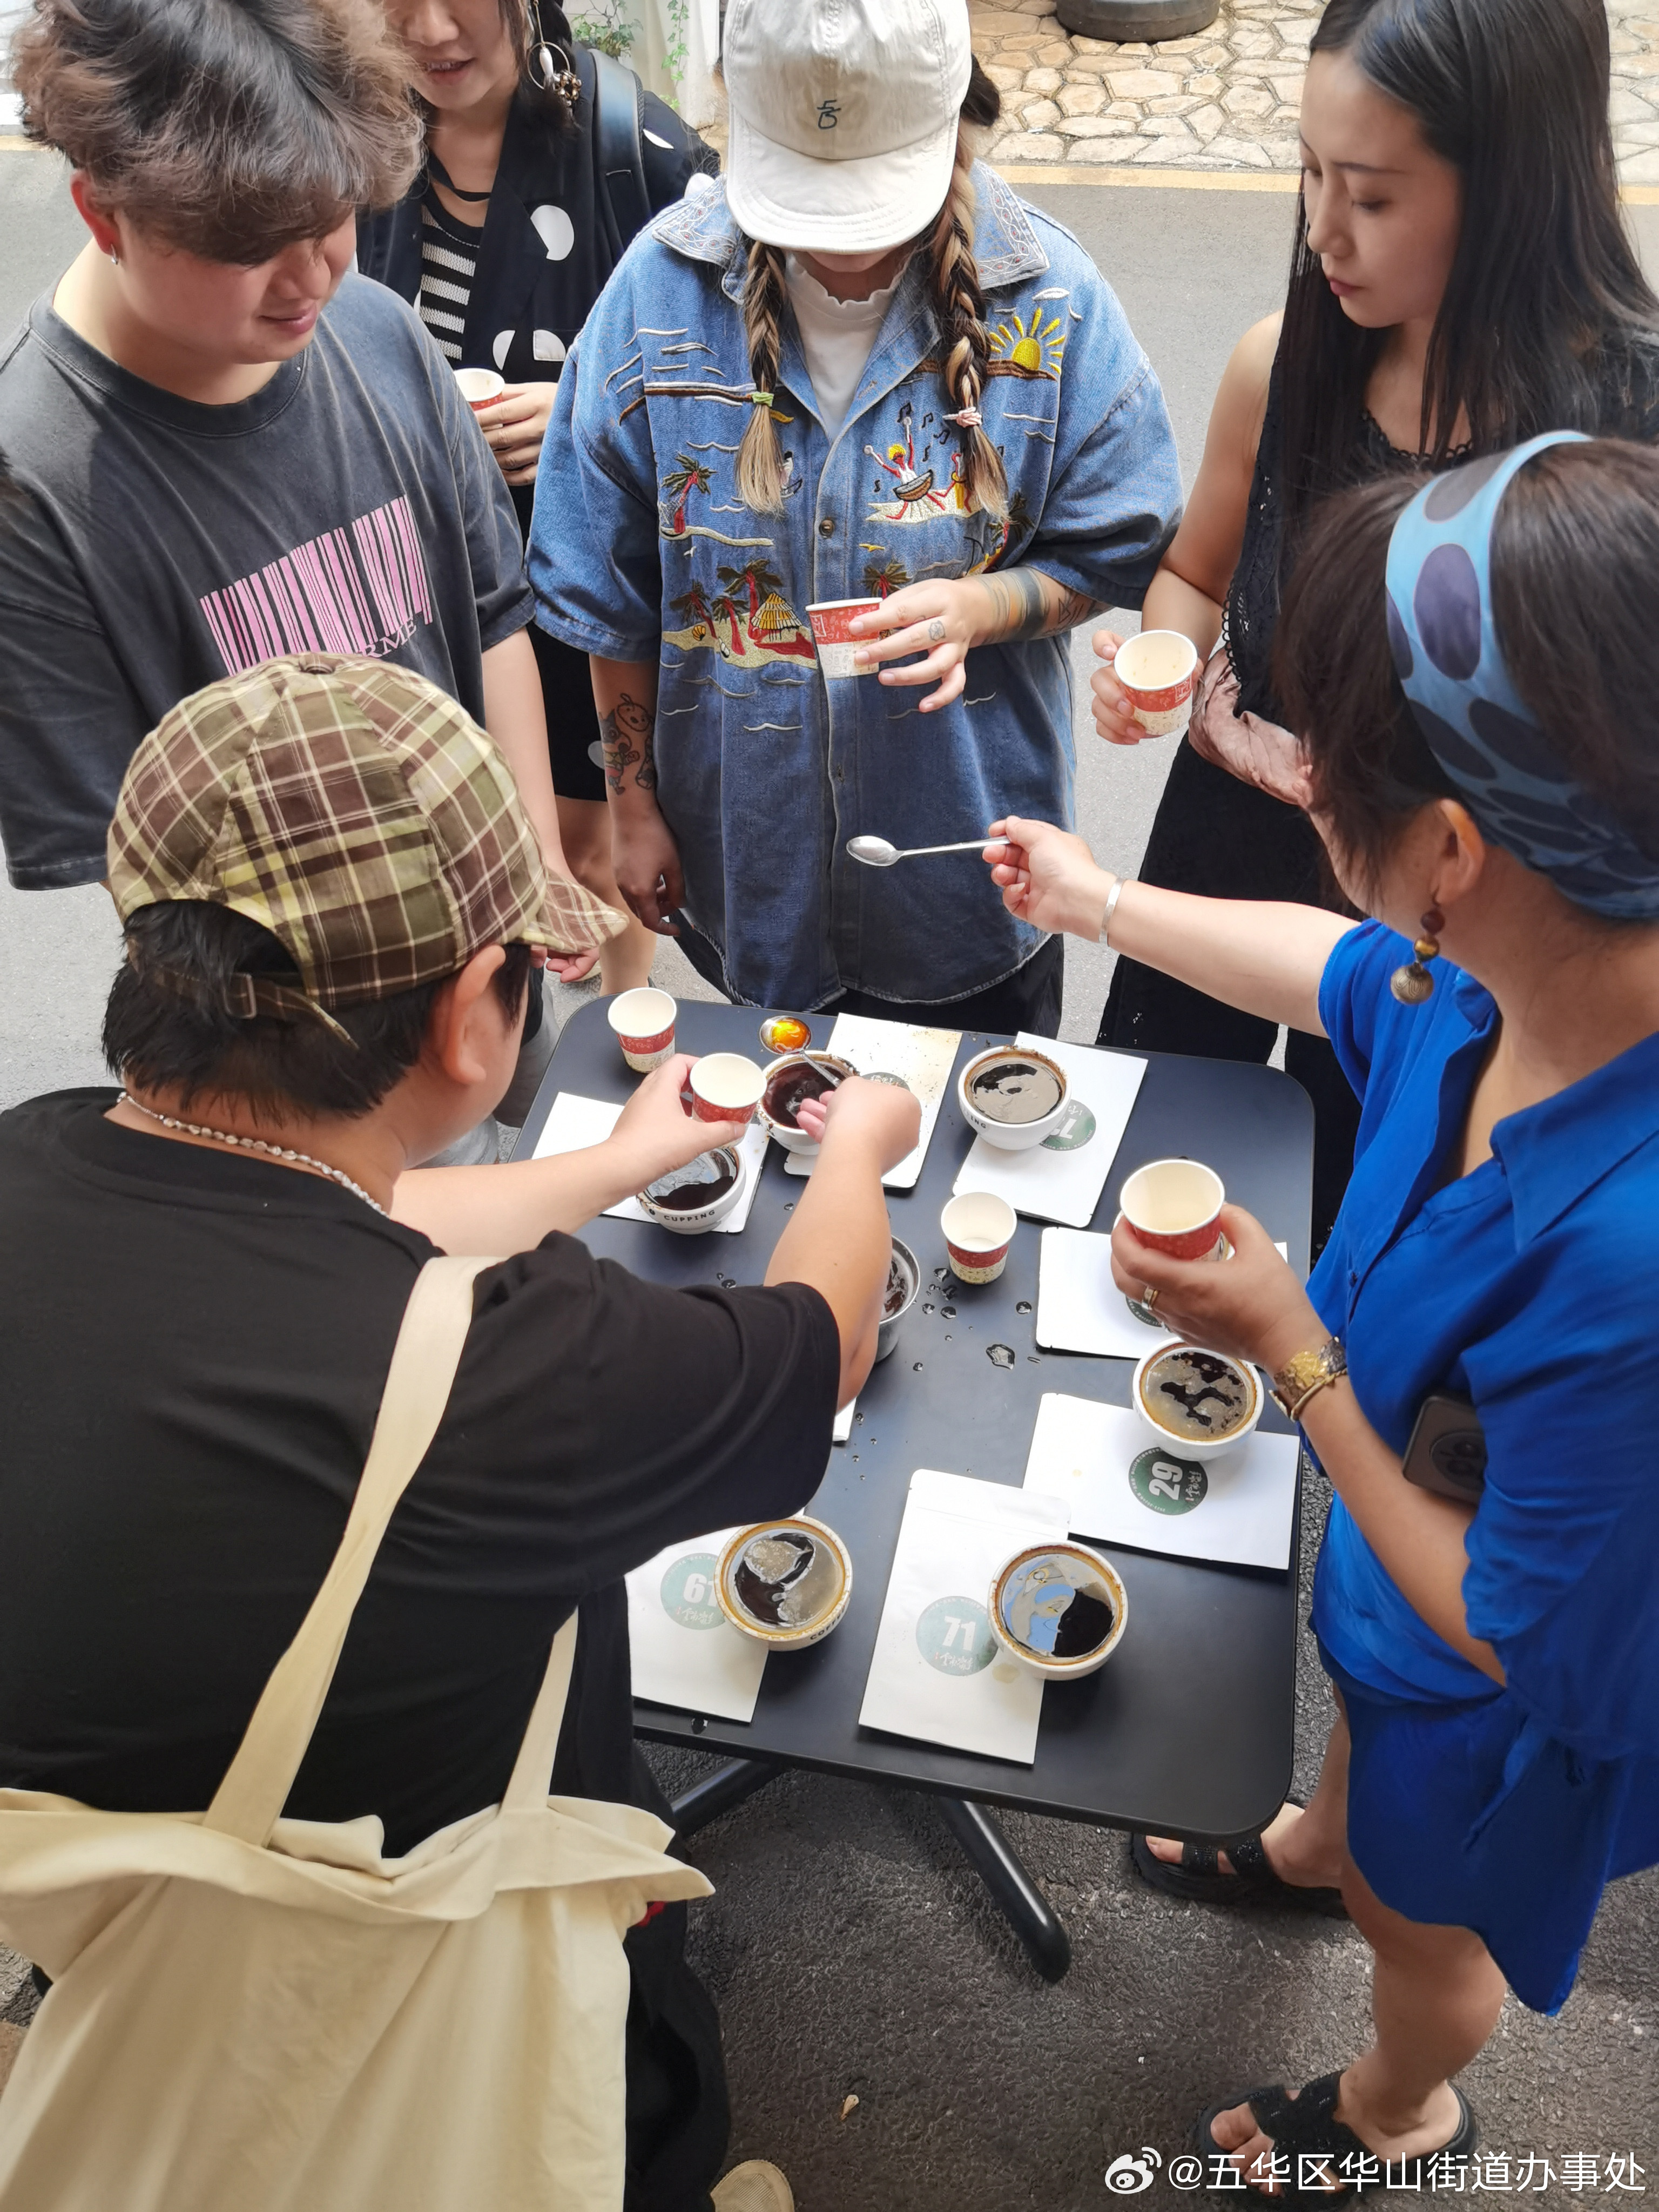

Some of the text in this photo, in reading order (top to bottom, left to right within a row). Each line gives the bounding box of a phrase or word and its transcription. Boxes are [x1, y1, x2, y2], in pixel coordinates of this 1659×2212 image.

[663, 1209, 716, 1222] CUPPING
[1149, 1461, 1183, 1501] 29
[683, 1573, 719, 1608] 61
[942, 1615, 976, 1651] 71
